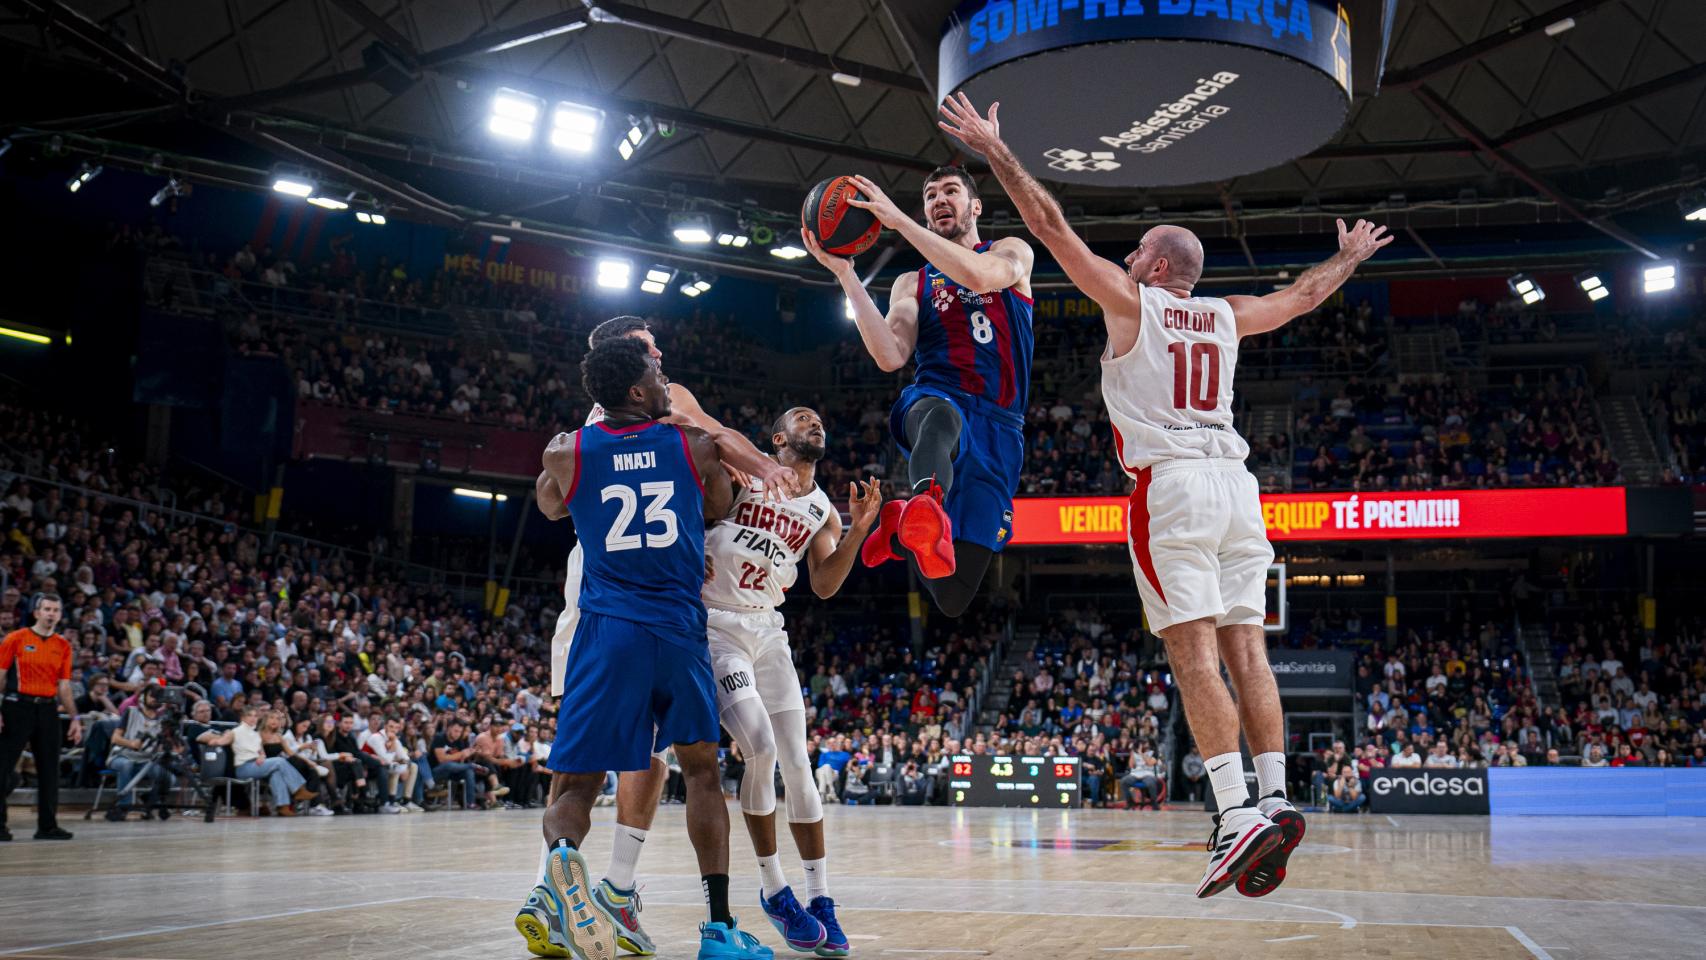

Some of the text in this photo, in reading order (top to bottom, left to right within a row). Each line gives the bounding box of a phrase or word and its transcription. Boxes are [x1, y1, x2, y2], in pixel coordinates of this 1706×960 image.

[1099, 71, 1240, 148] Assistència
[1126, 104, 1231, 153] Sanitària
[486, 261, 525, 285] QUE
[530, 268, 556, 289] UN
[970, 311, 993, 344] 8
[1164, 307, 1215, 333] COLOM
[1167, 341, 1220, 411] 10
[613, 451, 656, 471] NNAJI
[600, 481, 679, 552] 23
[735, 502, 811, 554] GIRONA
[1059, 495, 1460, 534] VENIR EQUIP TÉ PREMI!!!
[733, 528, 786, 567] FIATC
[739, 561, 768, 591] 22
[954, 763, 972, 775] 82
[990, 763, 1013, 776] 4.3
[1055, 764, 1073, 777] 55
[1373, 772, 1484, 795] endesa
